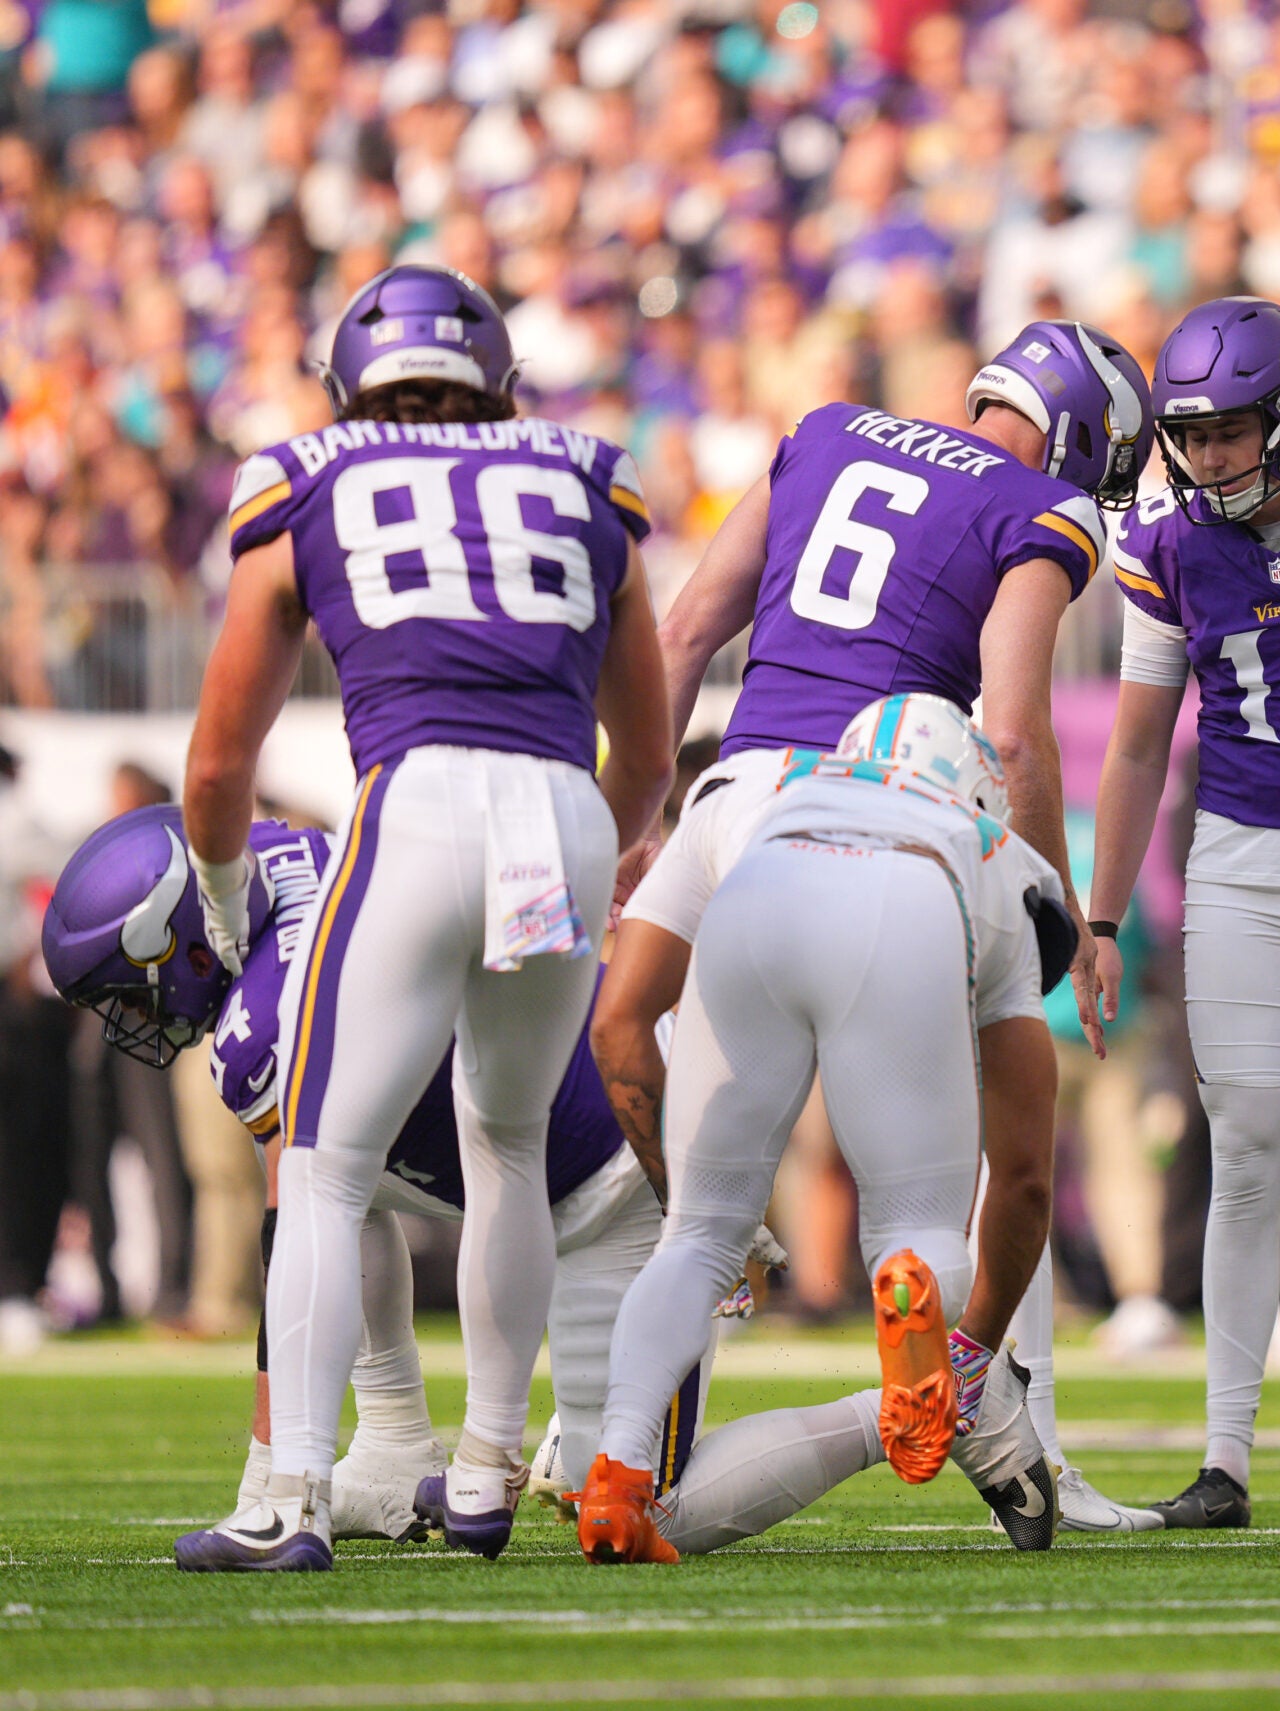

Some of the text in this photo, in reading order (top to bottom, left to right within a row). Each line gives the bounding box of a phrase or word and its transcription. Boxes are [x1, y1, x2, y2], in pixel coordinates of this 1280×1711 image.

[289, 418, 599, 477] BARTHOLOMEW
[844, 411, 1005, 477] HEKKER
[332, 457, 597, 632] 86
[790, 460, 930, 630] 6
